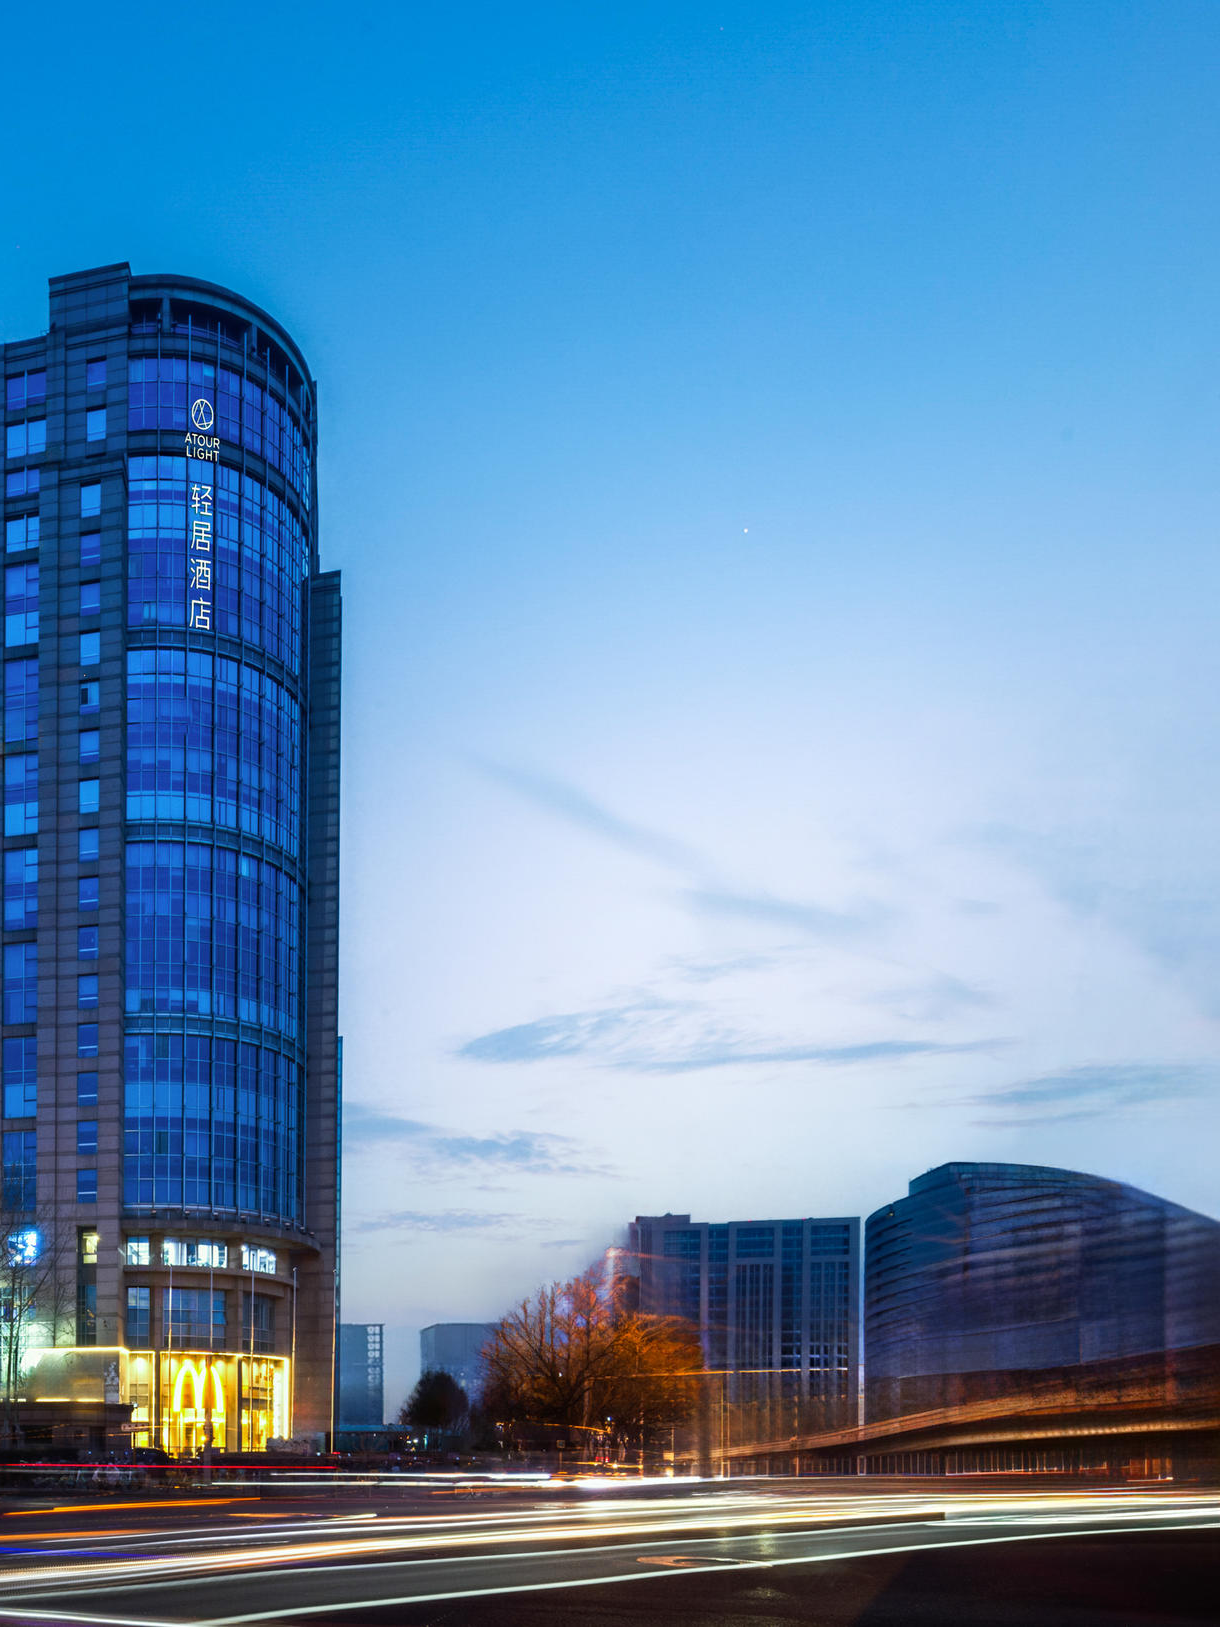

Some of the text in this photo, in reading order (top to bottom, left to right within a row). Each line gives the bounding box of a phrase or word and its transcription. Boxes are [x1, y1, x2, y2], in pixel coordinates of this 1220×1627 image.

[185, 432, 220, 450] ATOUR
[186, 445, 220, 462] LIGHT
[189, 484, 213, 630] 轻居酒店
